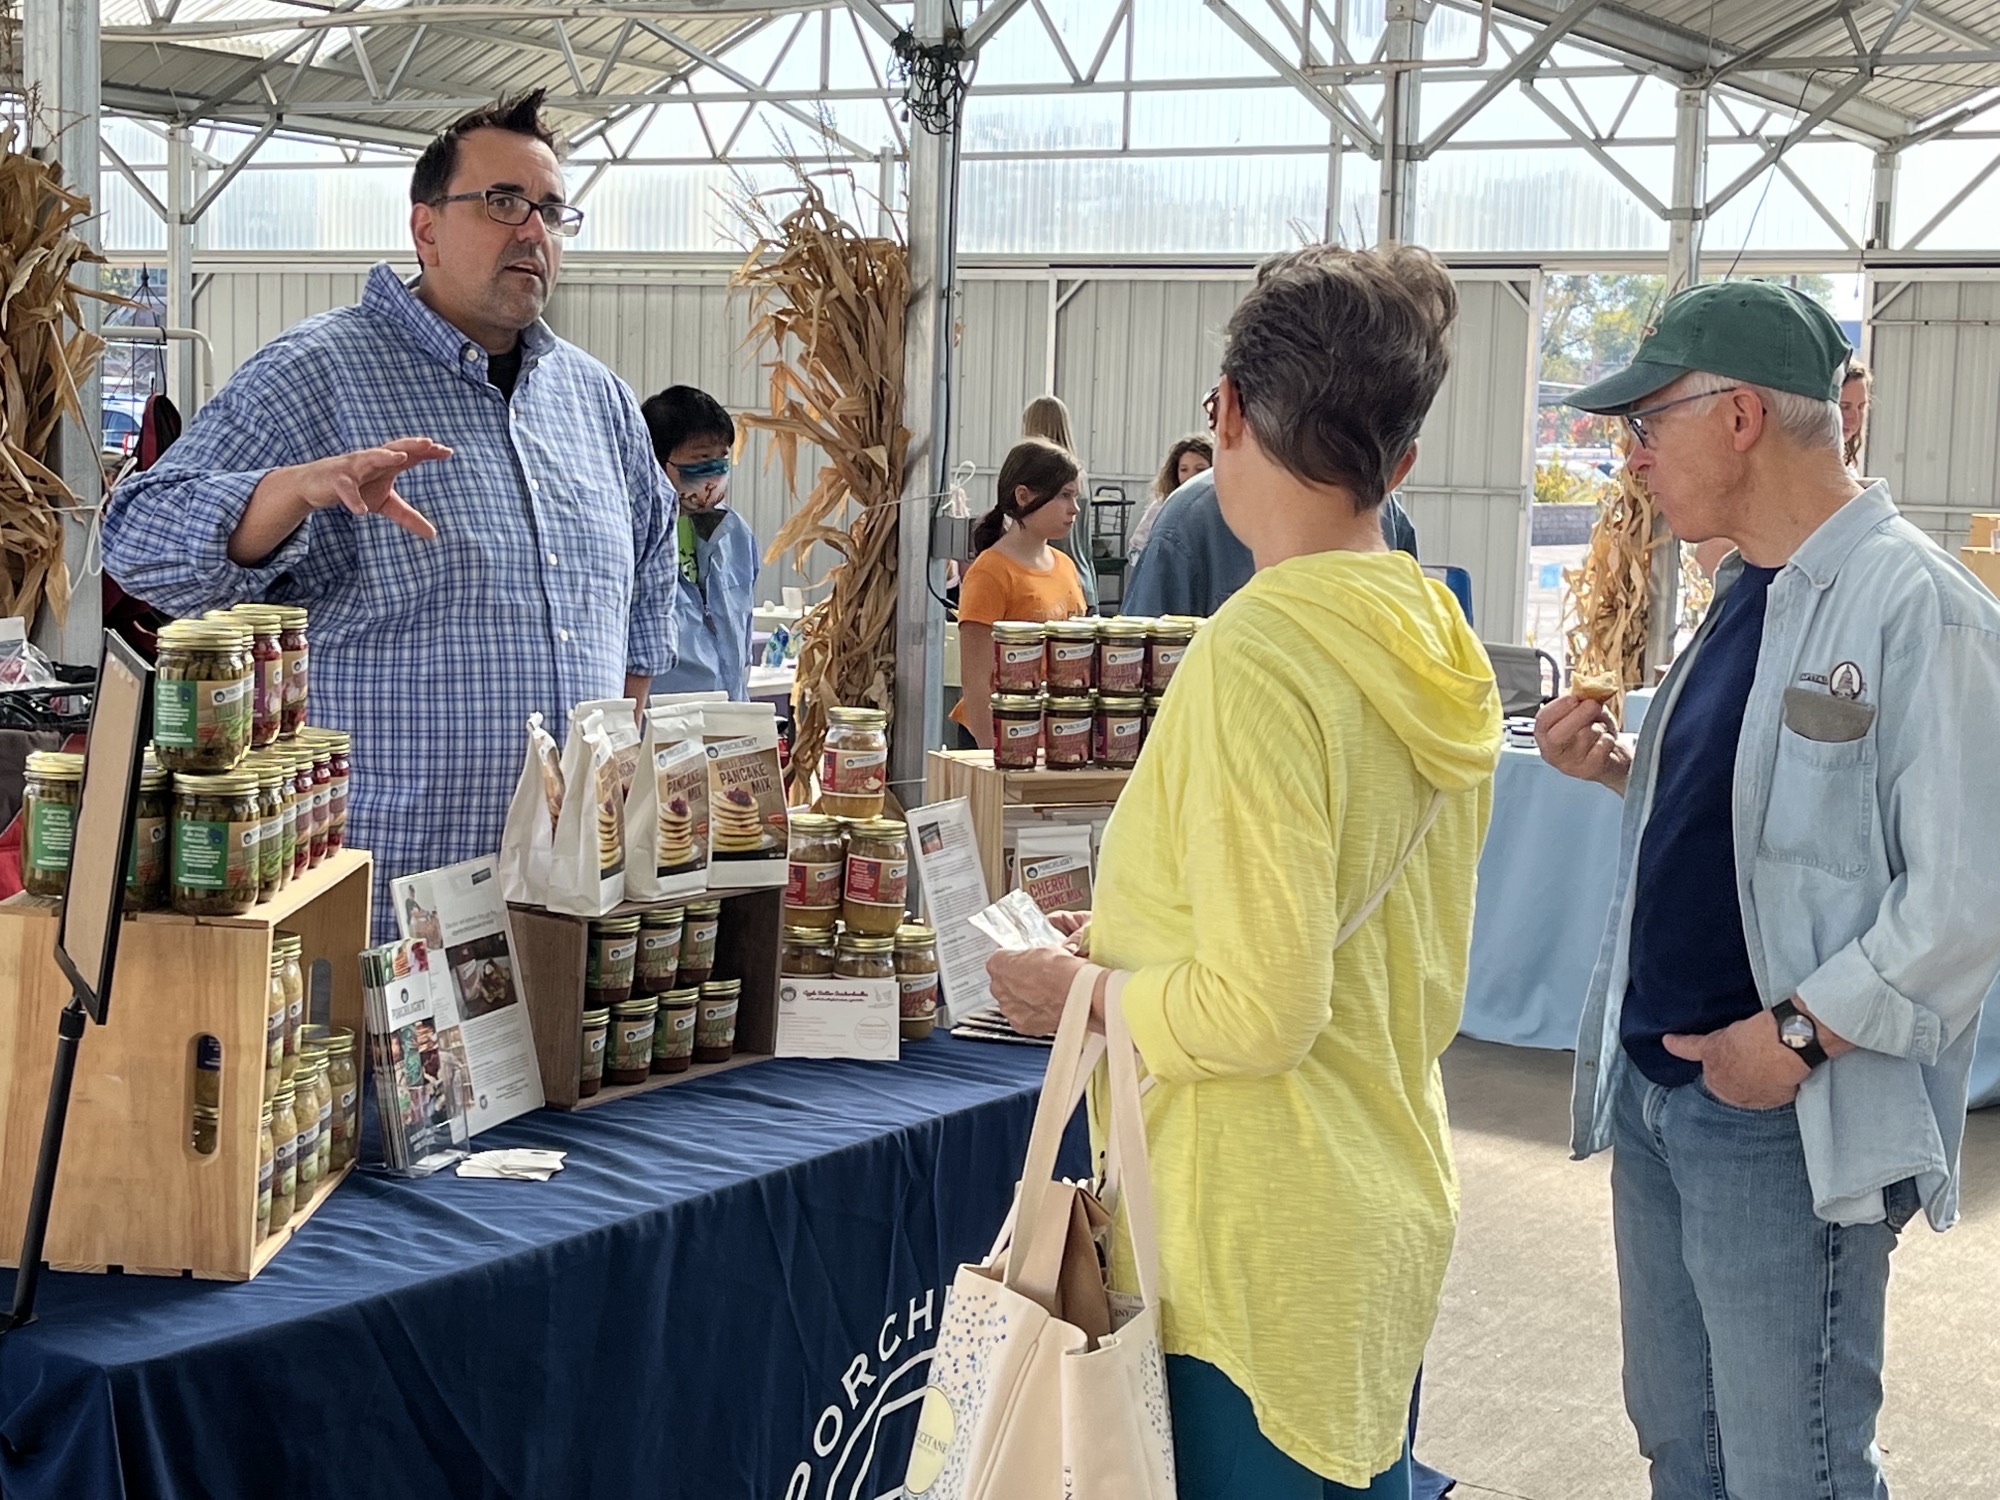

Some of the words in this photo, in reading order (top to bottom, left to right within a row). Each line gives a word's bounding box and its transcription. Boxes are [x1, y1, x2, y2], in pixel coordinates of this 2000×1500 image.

[667, 768, 701, 797] PANCAKE
[718, 762, 769, 786] PANCAKE
[750, 777, 773, 795] MIX
[1028, 873, 1072, 898] CHERRY
[784, 1284, 953, 1500] PORCH
